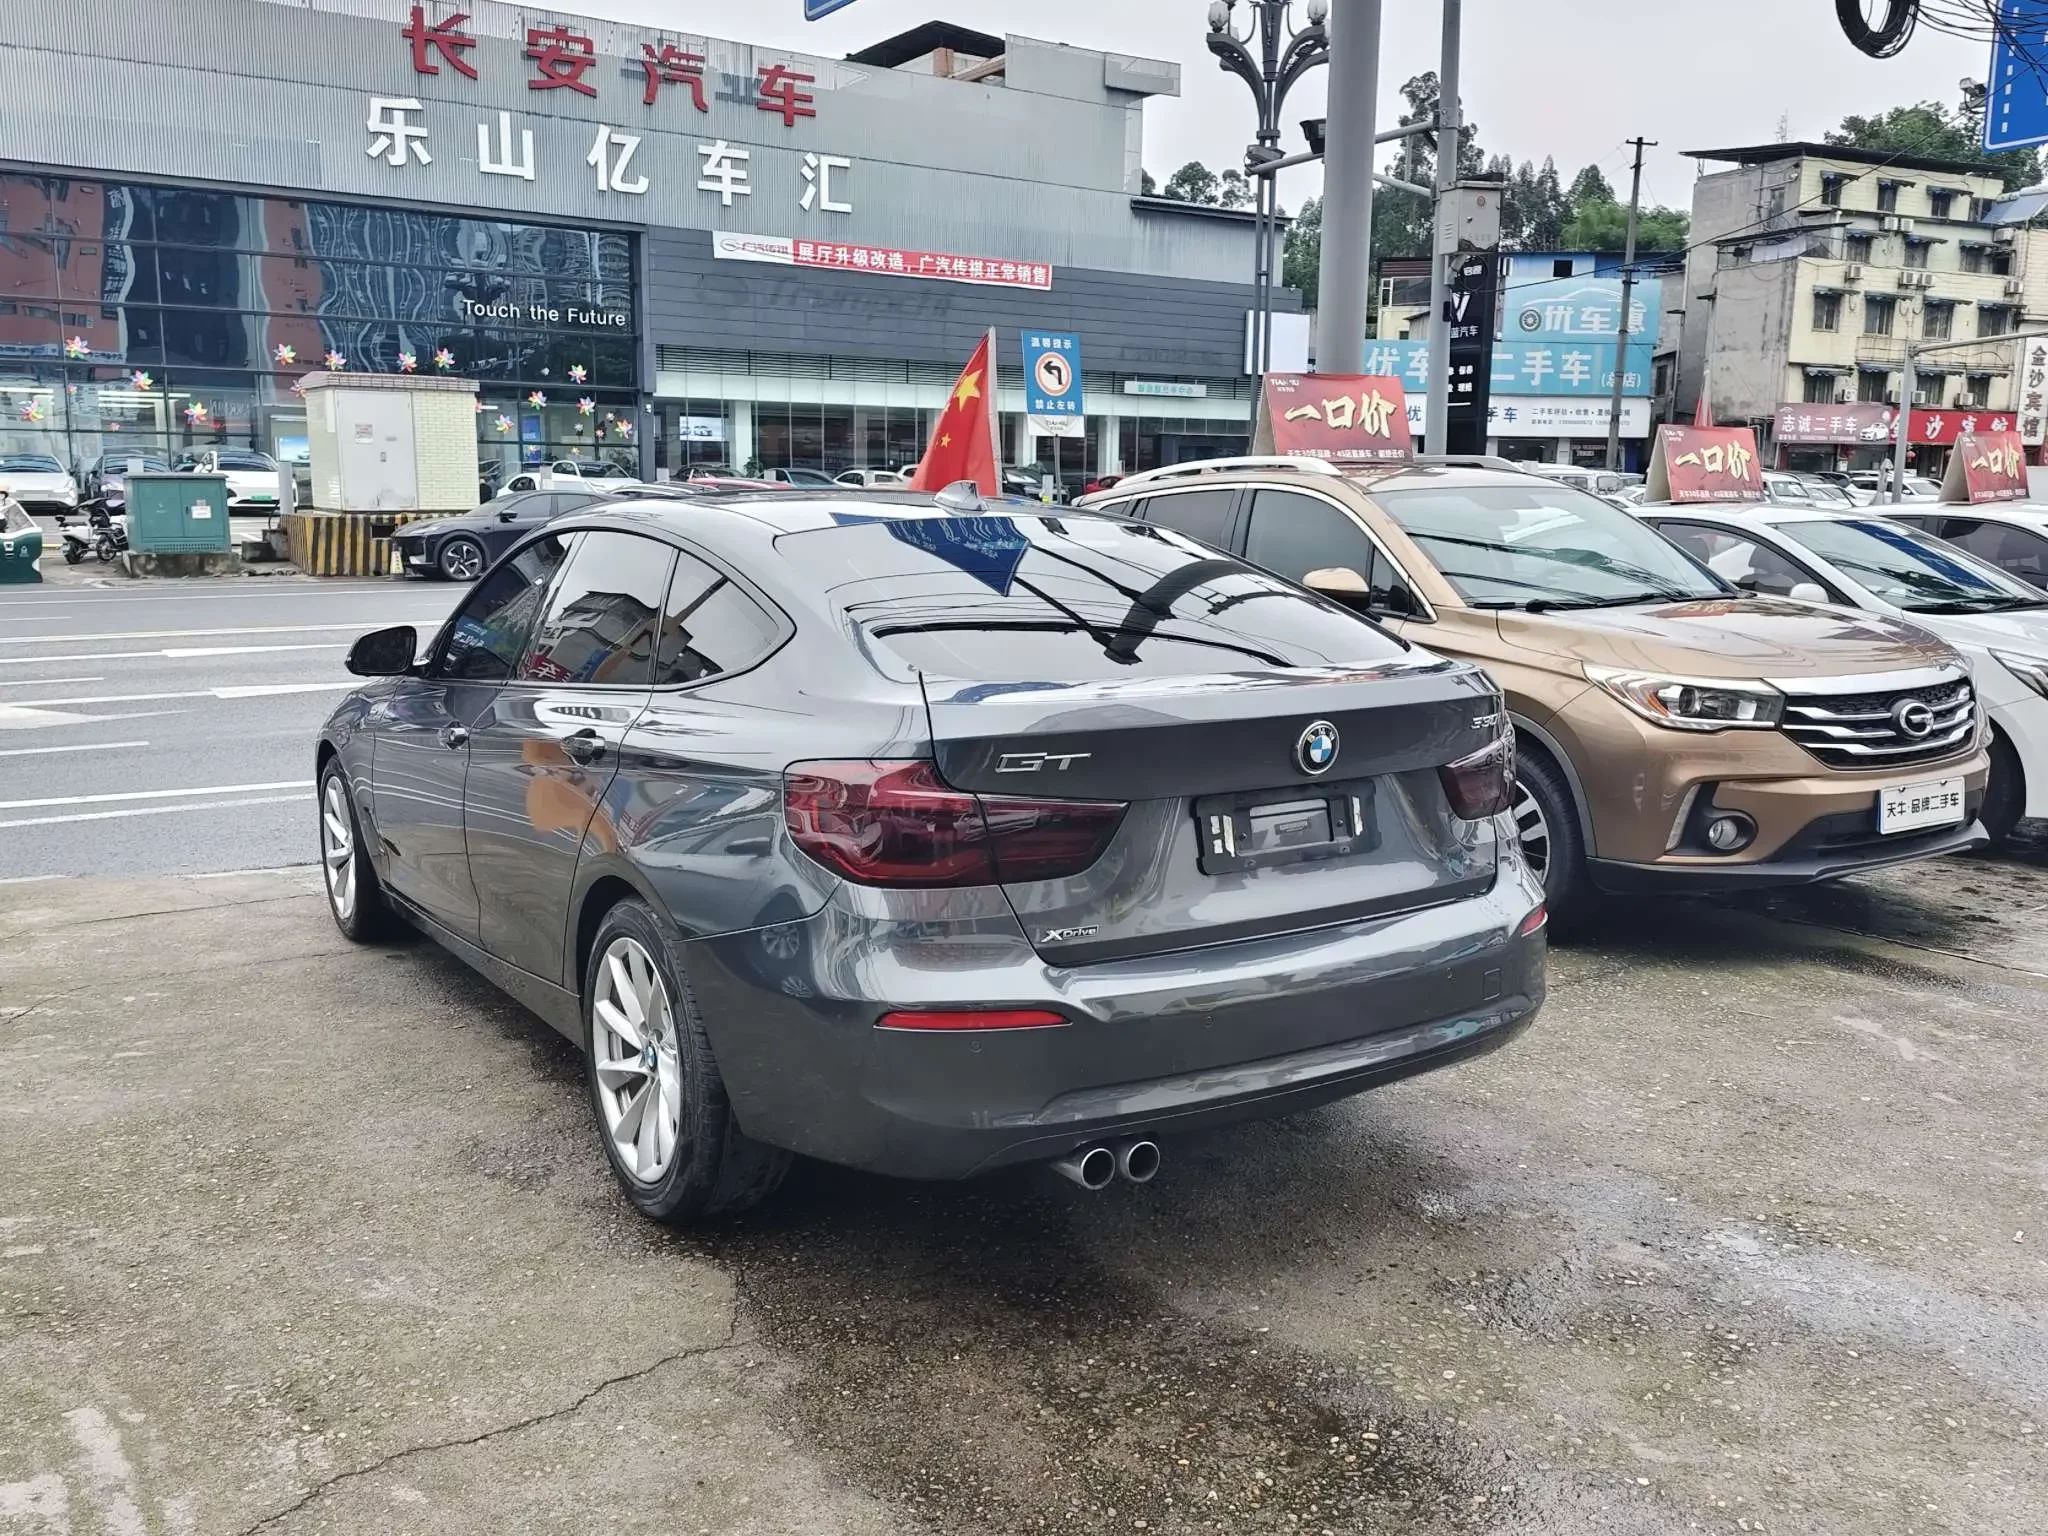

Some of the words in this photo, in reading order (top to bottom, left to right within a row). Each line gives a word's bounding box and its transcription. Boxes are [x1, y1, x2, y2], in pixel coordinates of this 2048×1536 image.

[402, 5, 817, 126] 长安汽车
[366, 97, 853, 213] 乐山亿车汇
[463, 300, 520, 319] Touch
[530, 305, 559, 322] the
[568, 308, 626, 327] Future
[1450, 325, 1480, 339] 蓝汽车
[2023, 344, 2047, 438] 金沙宾馆
[1284, 388, 1398, 439] 一口价
[1781, 414, 1858, 435] 志诚二手车
[1675, 440, 1752, 481] 一口价
[1971, 438, 2020, 481] 一口价
[1306, 727, 1336, 744] BMW
[995, 752, 1092, 773] GT
